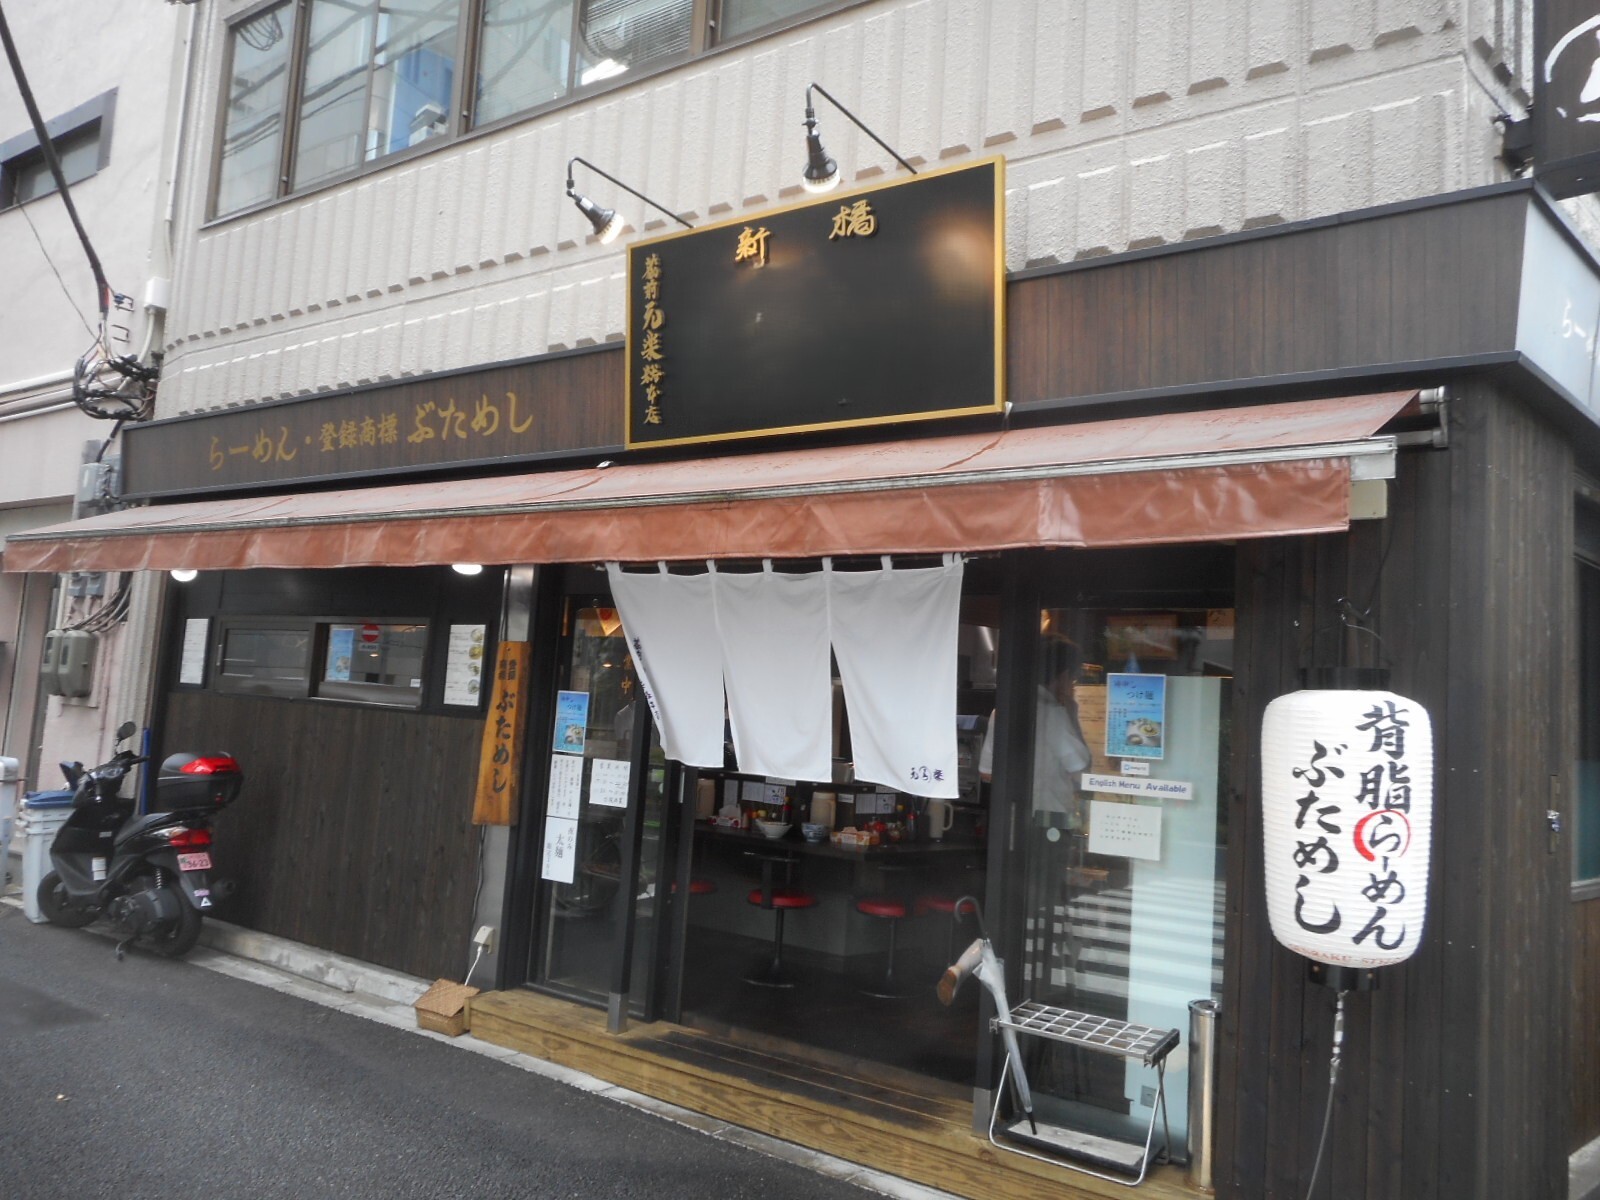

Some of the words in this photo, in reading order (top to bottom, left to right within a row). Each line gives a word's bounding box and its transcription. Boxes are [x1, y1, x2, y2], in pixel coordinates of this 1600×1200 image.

[407, 391, 534, 444] ぶためし
[492, 691, 515, 793] ぶためし
[1088, 777, 1117, 788] English
[1118, 781, 1141, 790] Menu
[1145, 782, 1188, 794] Available
[1292, 739, 1349, 935] ぶためし
[1353, 700, 1412, 951] 背脂らーめん
